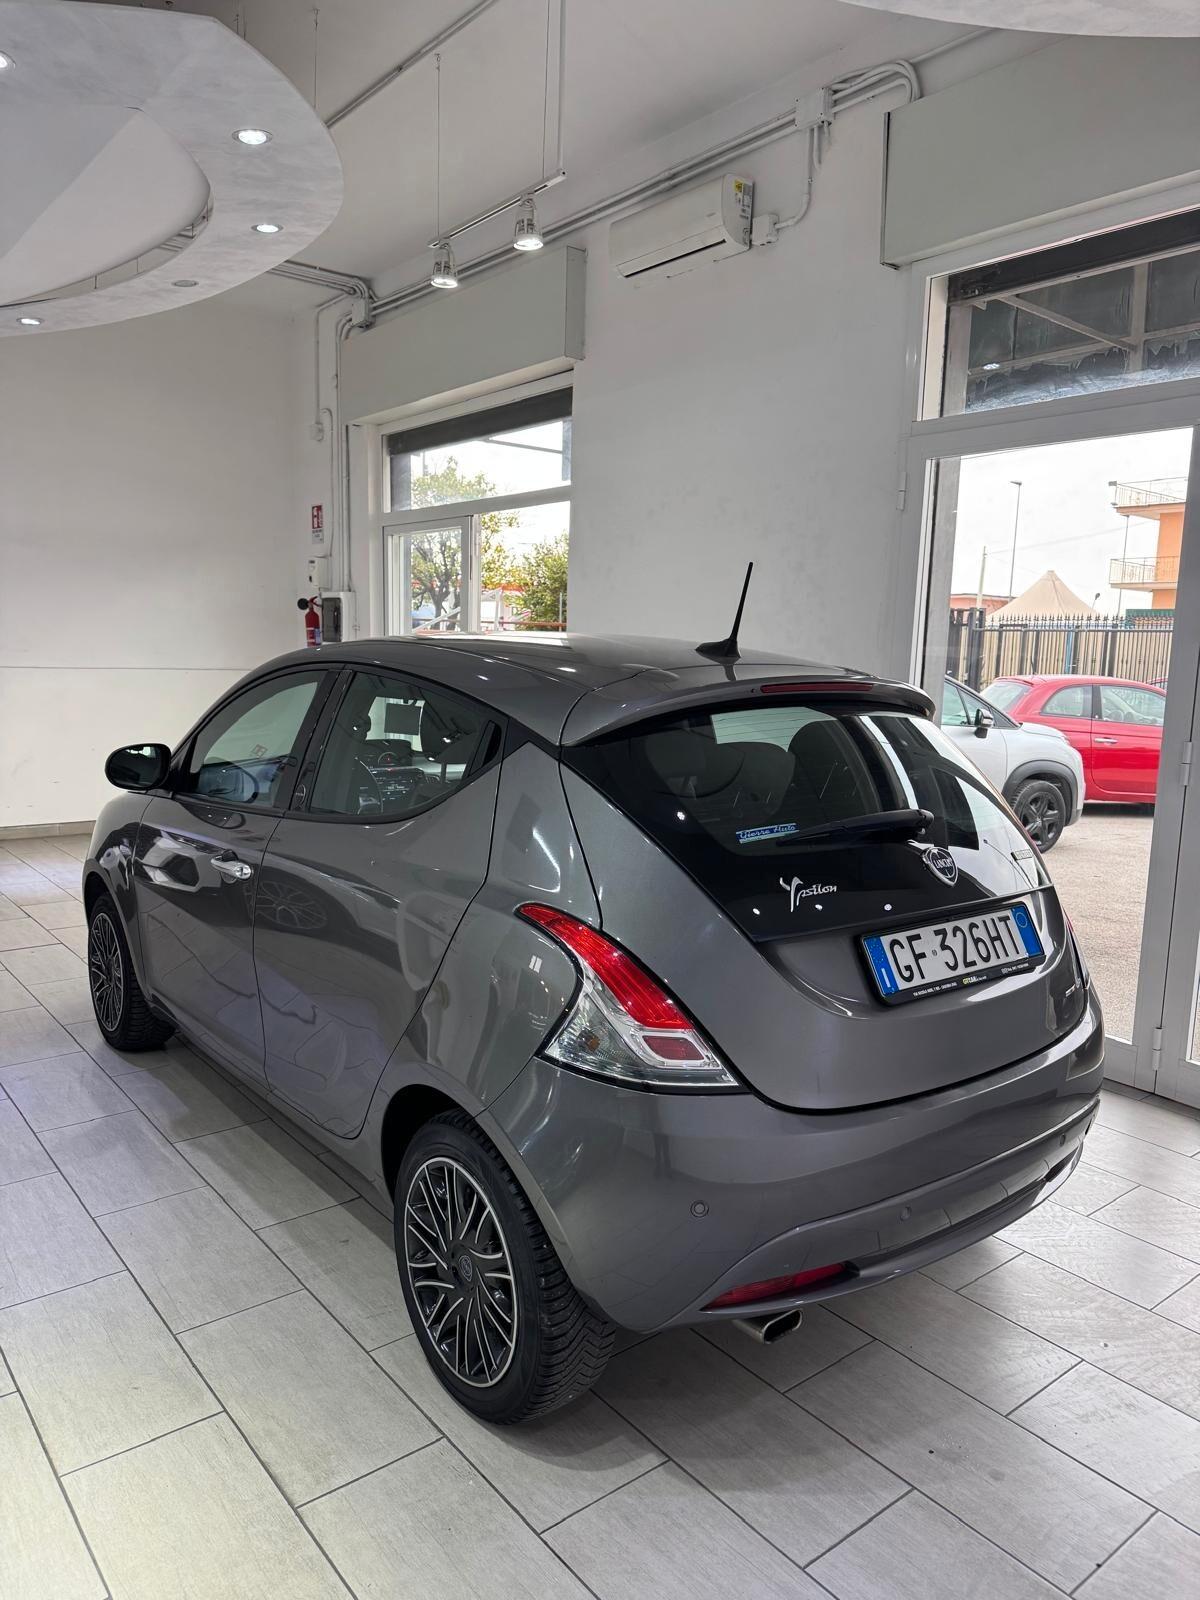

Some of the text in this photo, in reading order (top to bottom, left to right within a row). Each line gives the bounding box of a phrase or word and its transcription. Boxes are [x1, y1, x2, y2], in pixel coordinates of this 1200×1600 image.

[934, 857, 953, 869] LANCIA
[780, 876, 837, 912] Ypsilon
[889, 933, 927, 983] GF
[934, 915, 1020, 972] 326HT
